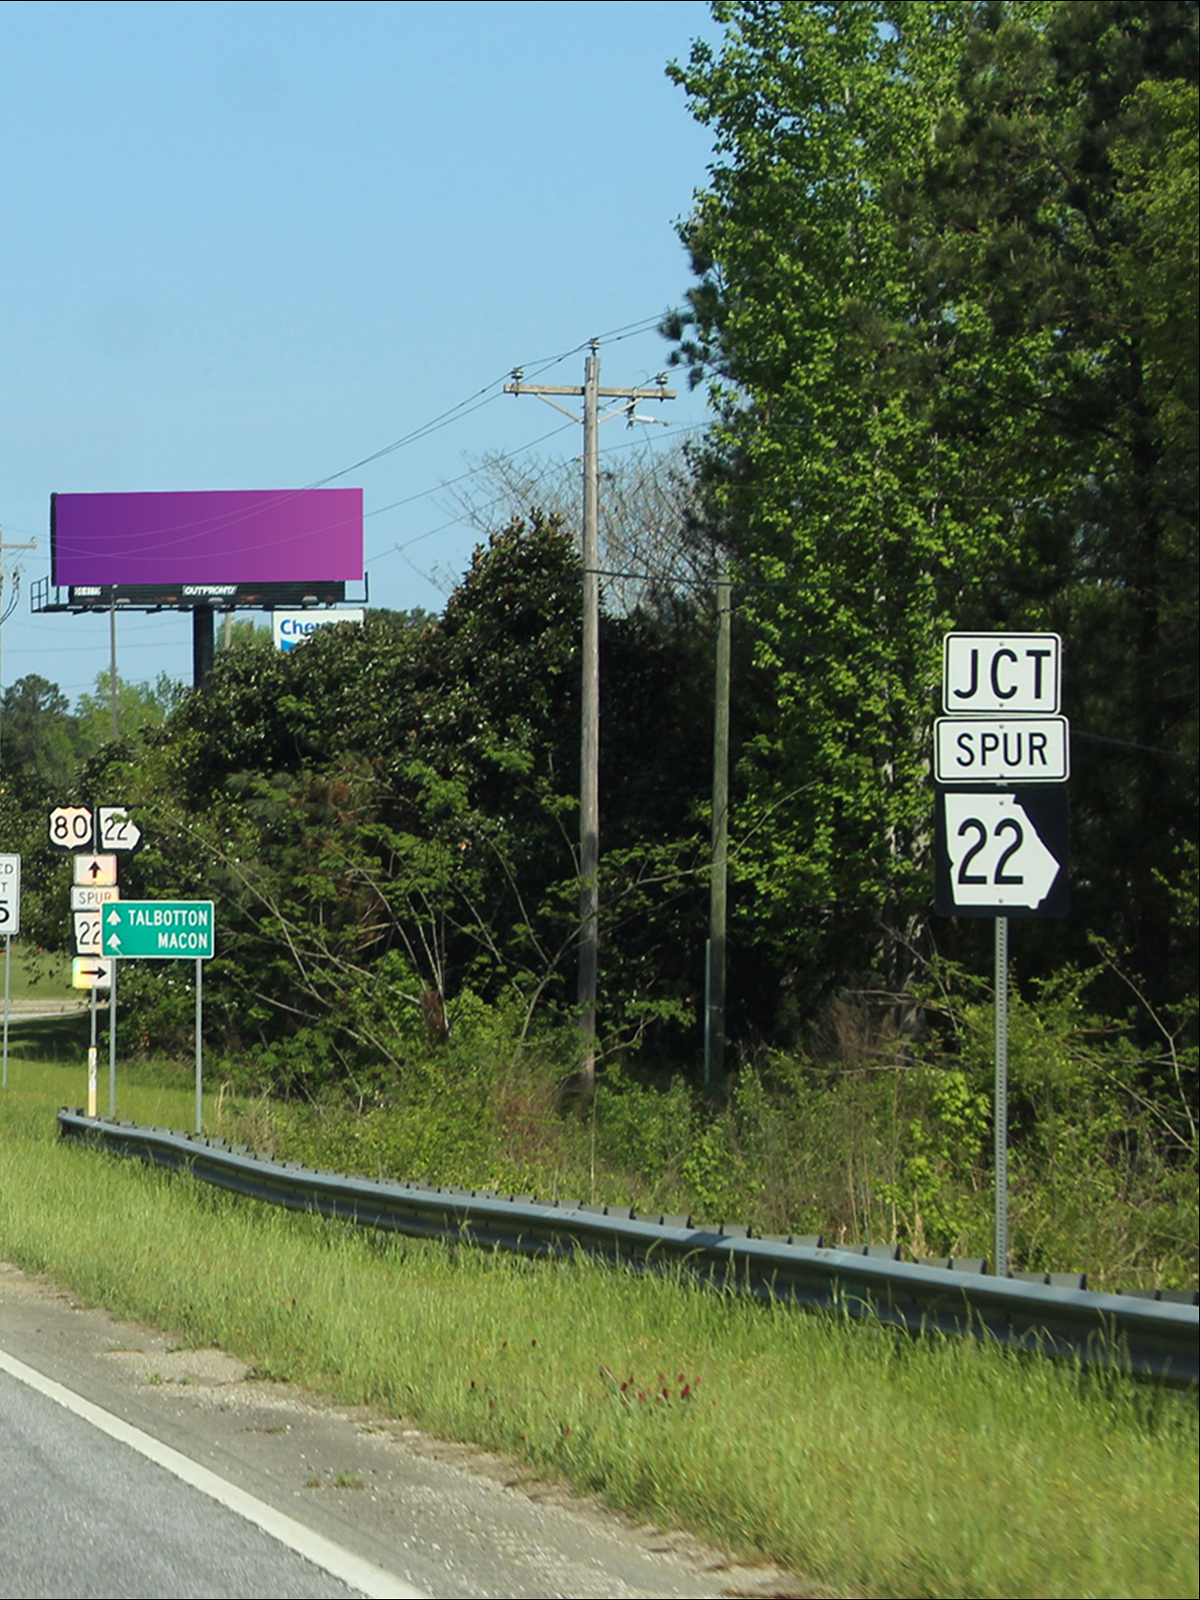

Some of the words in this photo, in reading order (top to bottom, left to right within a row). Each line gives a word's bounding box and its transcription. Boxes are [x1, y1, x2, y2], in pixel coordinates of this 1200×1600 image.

[953, 648, 1051, 700] JCT
[956, 732, 1048, 767] SPUR
[53, 815, 88, 839] 80
[957, 817, 1024, 885] 22
[78, 891, 112, 905] SPUR
[128, 909, 208, 926] TALBOTTON
[79, 921, 101, 945] 22
[157, 932, 208, 949] MACON
